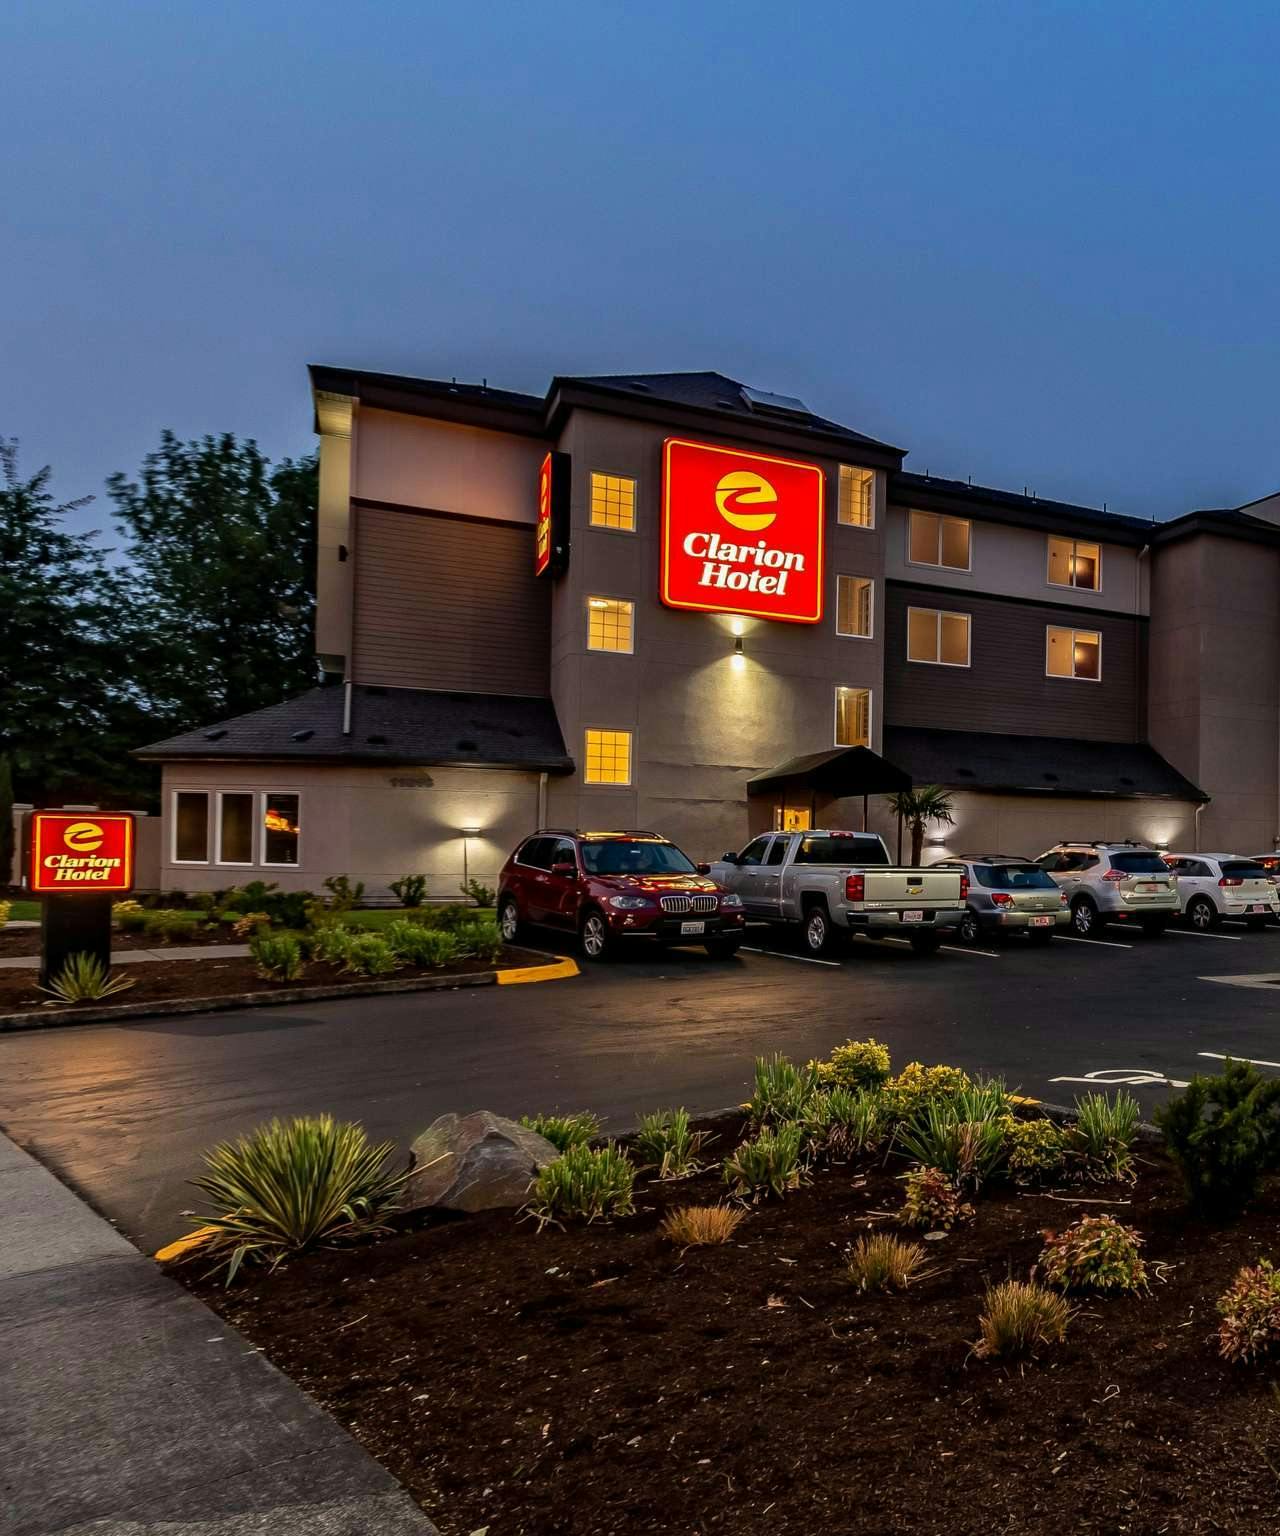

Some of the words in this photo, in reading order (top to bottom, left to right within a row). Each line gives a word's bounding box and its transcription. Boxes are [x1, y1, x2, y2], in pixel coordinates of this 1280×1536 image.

[683, 532, 805, 571] Clarion
[698, 561, 788, 596] Hotel
[44, 854, 121, 868] Clarion
[54, 867, 111, 881] Hotel
